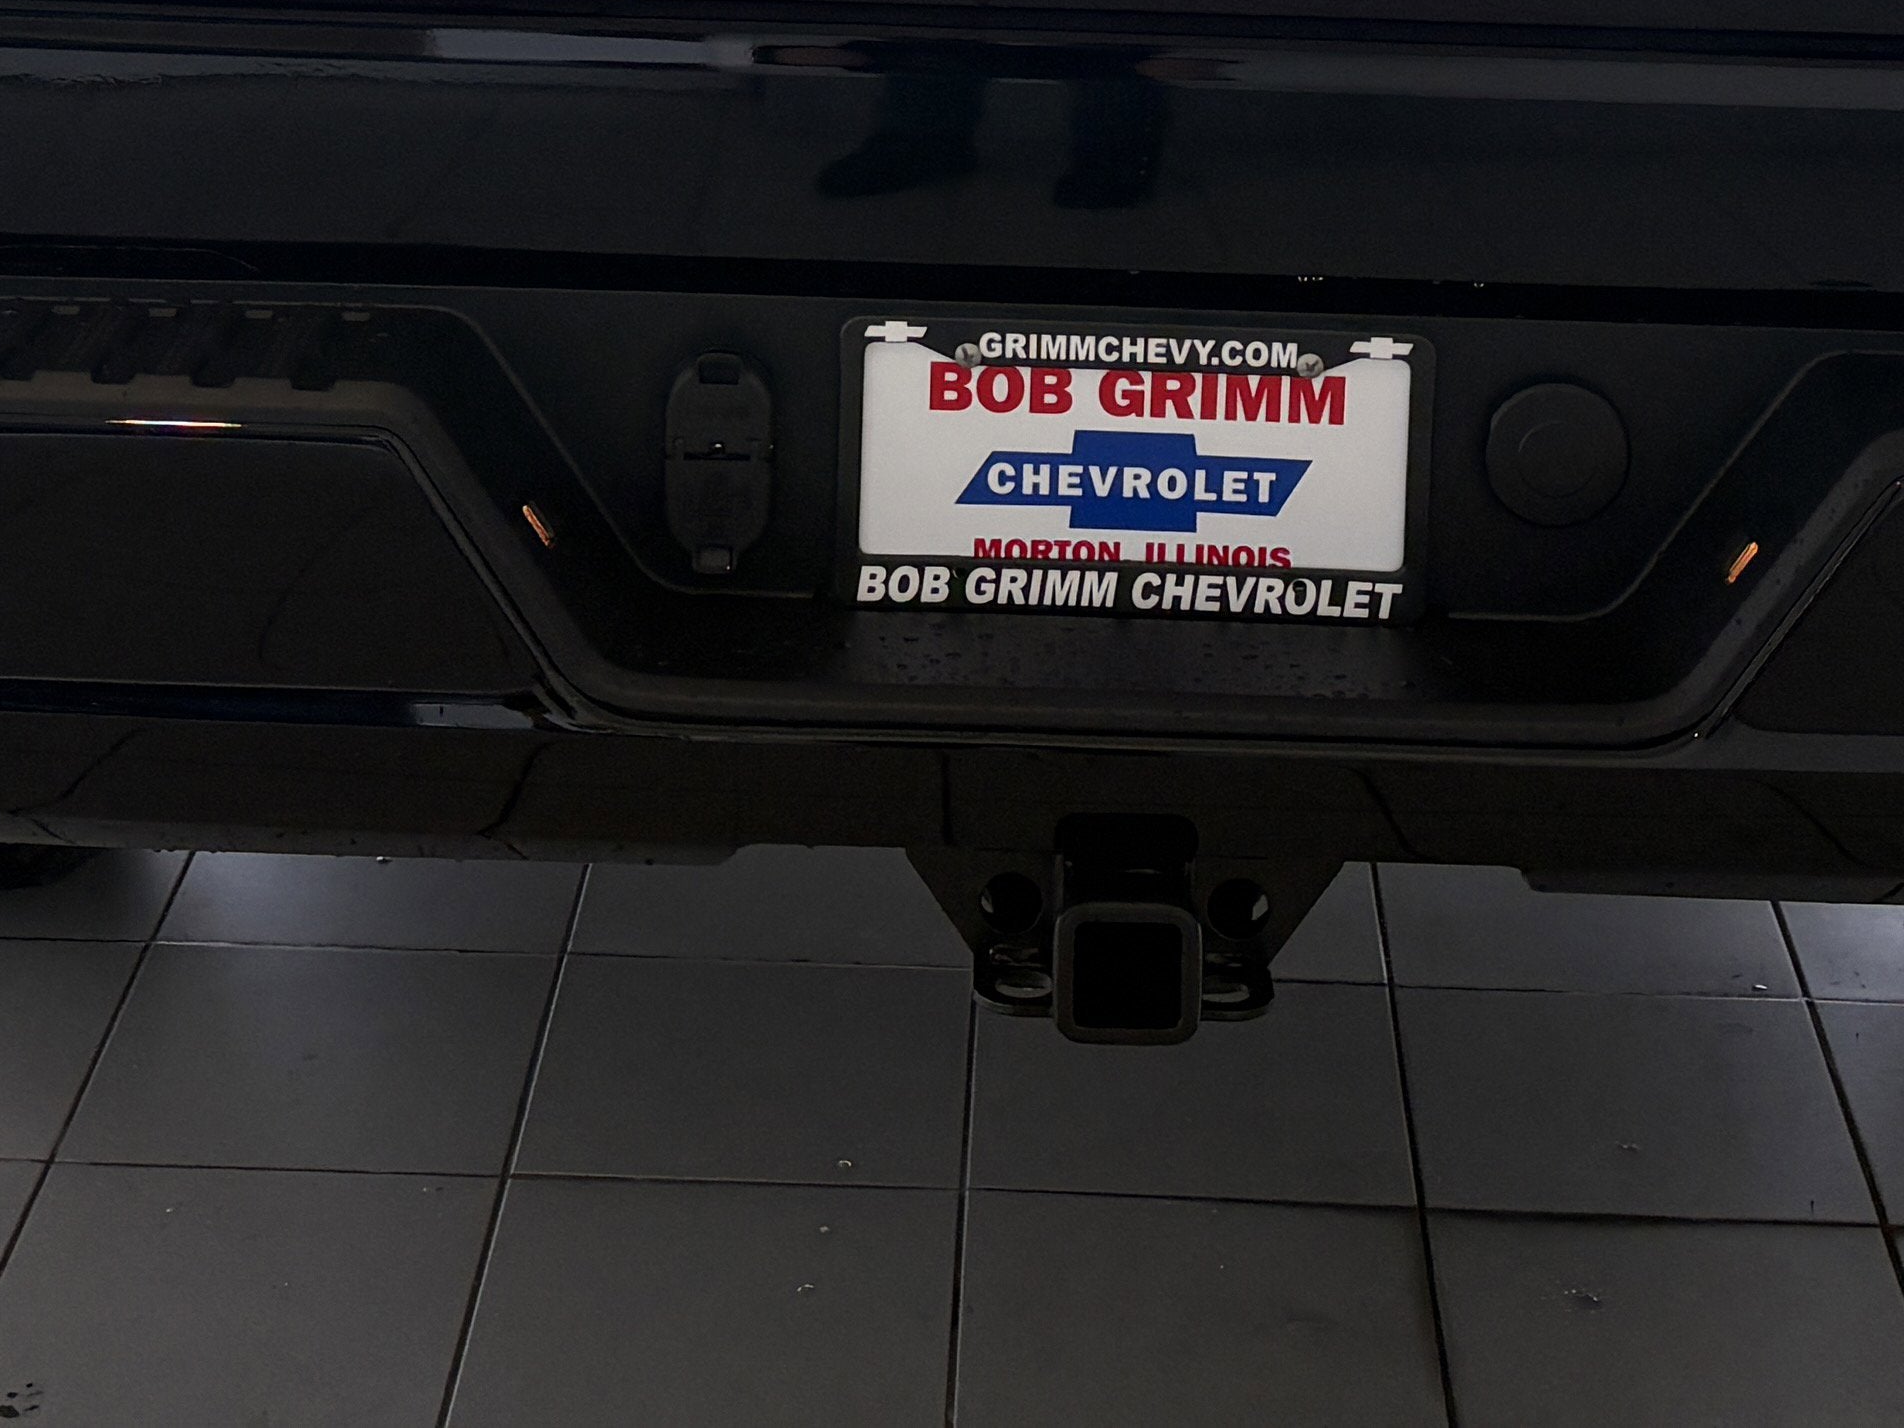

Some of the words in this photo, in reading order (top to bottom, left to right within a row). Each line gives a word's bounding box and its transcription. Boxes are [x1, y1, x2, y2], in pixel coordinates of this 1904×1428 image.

[979, 331, 1298, 369] GRIMMCHEVY.COM
[929, 361, 1074, 415] BOB
[1098, 370, 1346, 425] GRIMM
[987, 462, 1277, 503] CHEVROLET
[1145, 541, 1292, 569] ILLINOIS
[856, 565, 951, 604] BOB
[965, 567, 1119, 608] GRIMM
[1131, 571, 1403, 620] CHEVROLET
